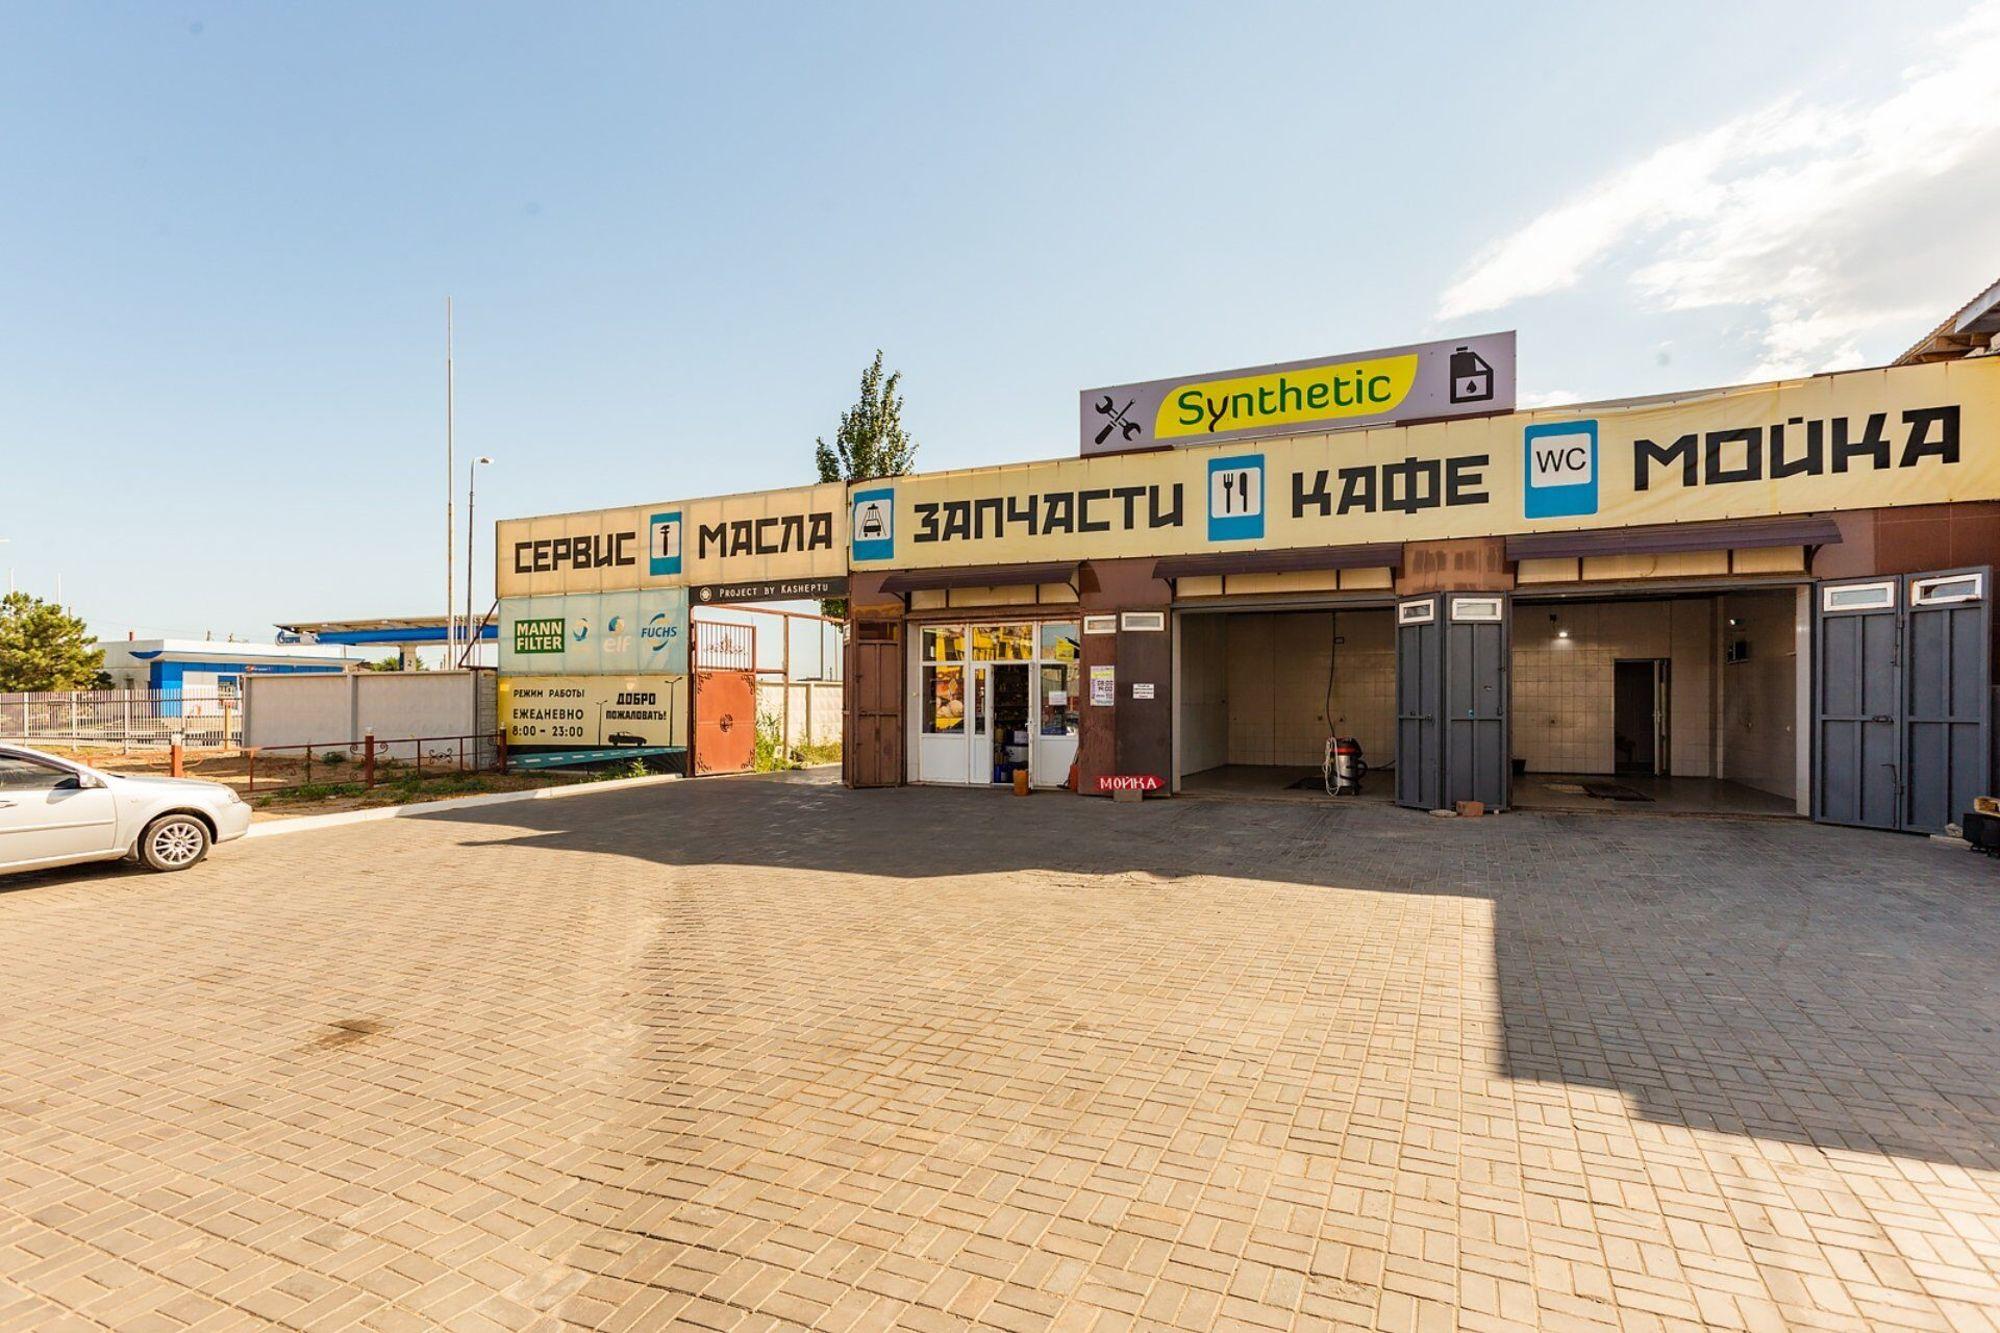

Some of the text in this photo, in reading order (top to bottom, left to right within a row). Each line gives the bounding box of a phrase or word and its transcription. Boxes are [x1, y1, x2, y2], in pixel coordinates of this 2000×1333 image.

[1178, 369, 1391, 432] Synthetic
[1634, 404, 1960, 491] МОЙКА
[1535, 446, 1587, 474] WC
[1292, 454, 1489, 518] КАФЕ
[914, 482, 1183, 543] ЗАПЧАСТИ
[698, 511, 833, 560] МАСЛА
[514, 531, 636, 574] СЕРВИС
[516, 621, 562, 636] MANN
[641, 626, 678, 638] FUCHS
[516, 635, 562, 650] FILTER
[603, 635, 632, 653] elf
[513, 689, 585, 698] РЕЖИМ РАБОТЫ
[616, 692, 656, 706] ДОБРО
[512, 708, 584, 720] ЕЖЕДНЕВНО
[605, 710, 667, 721] ПОЖАЛОВАТЬ!
[512, 725, 536, 737] 8:00
[552, 725, 583, 737] 23:00
[1100, 776, 1157, 790] МОЙКА
